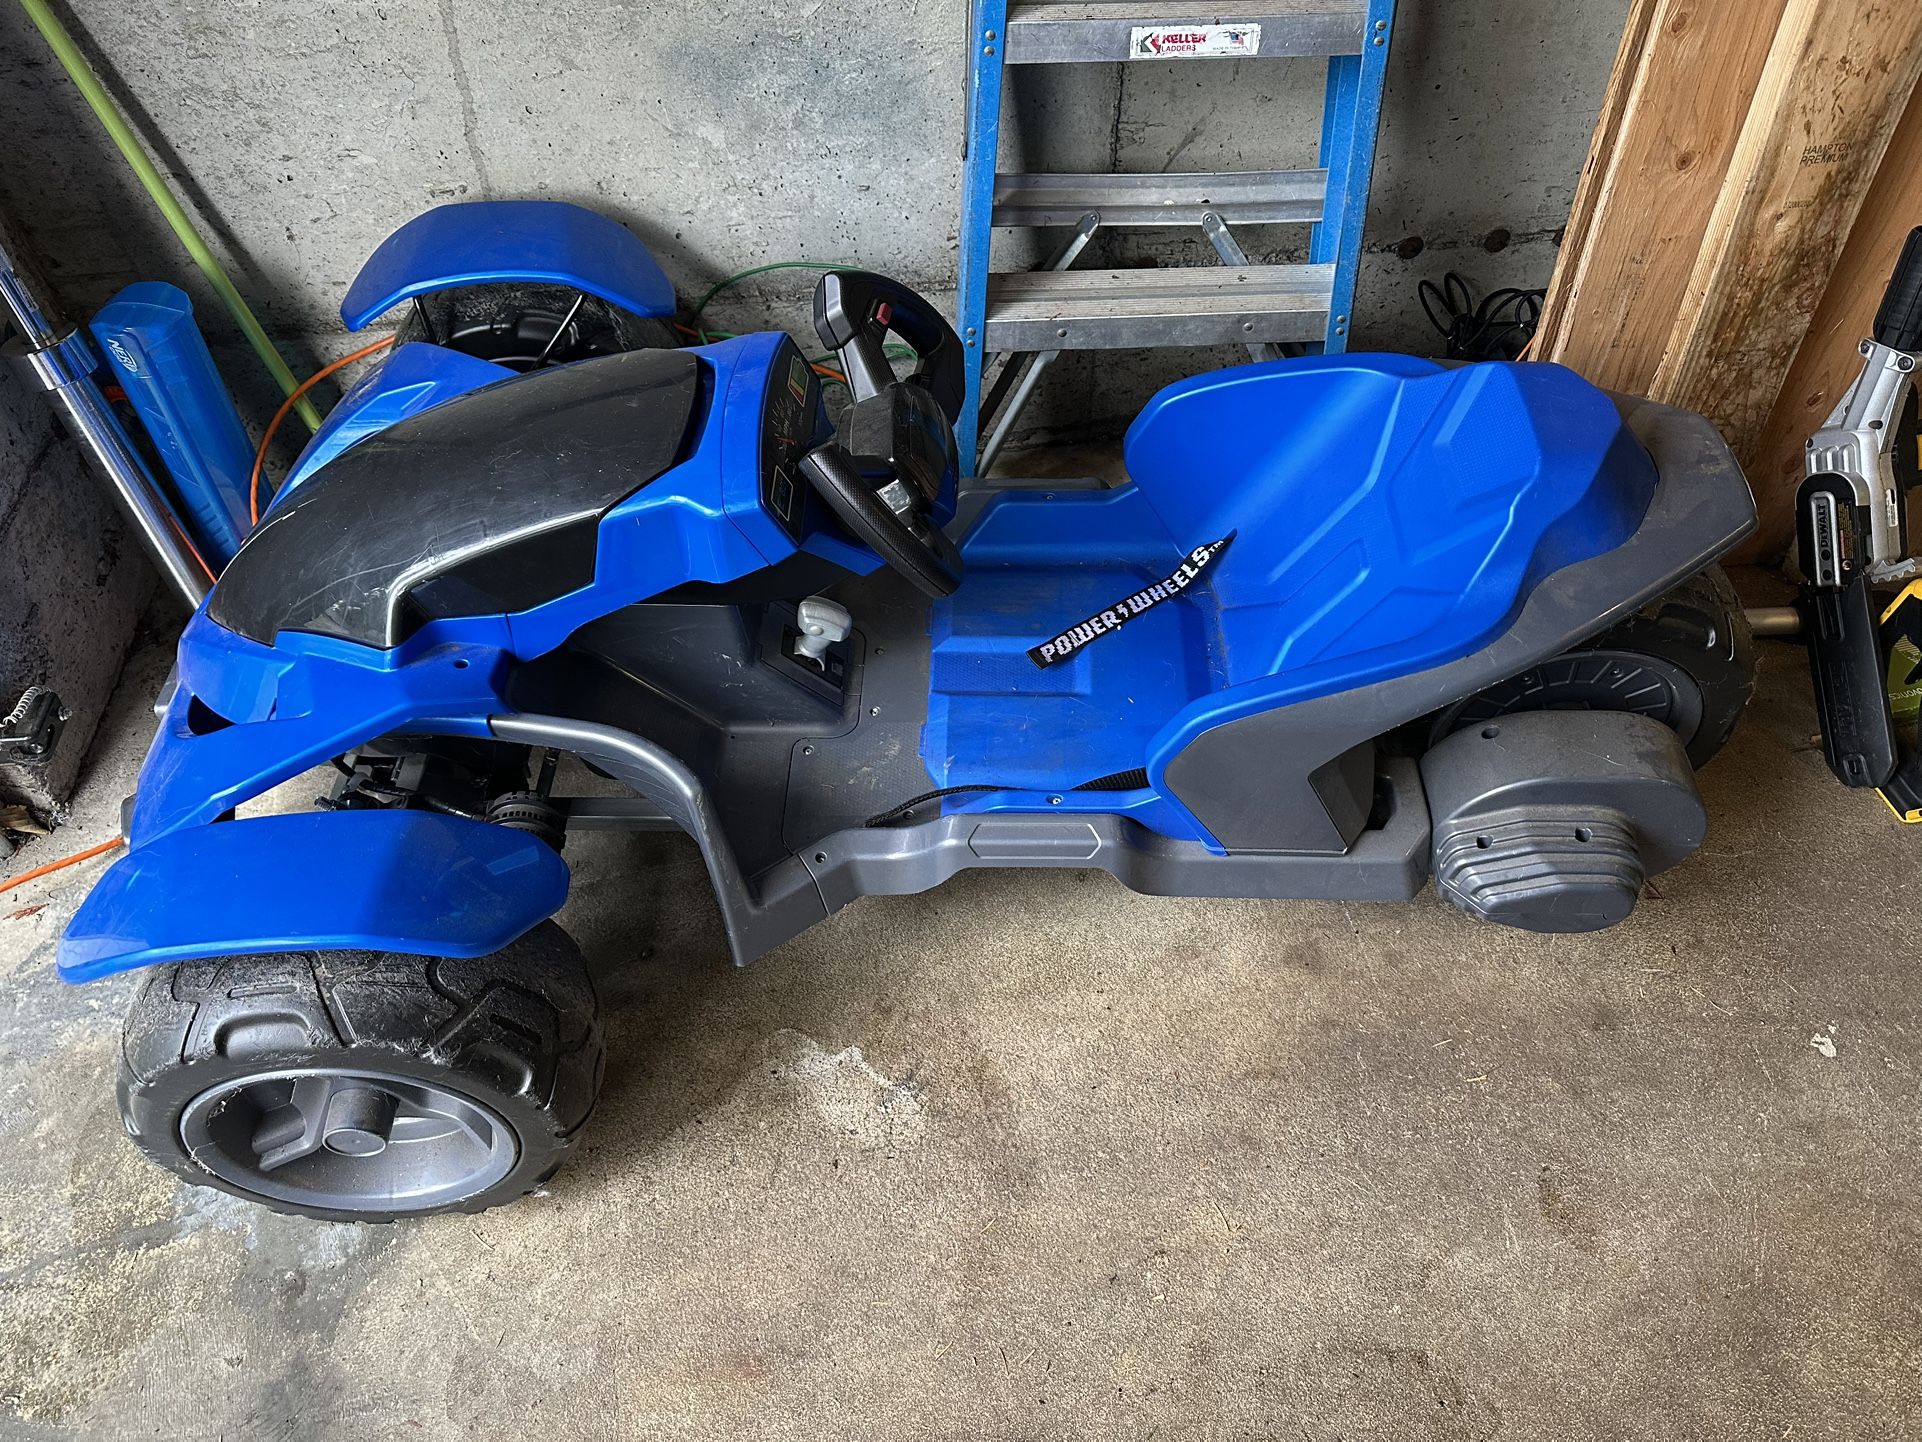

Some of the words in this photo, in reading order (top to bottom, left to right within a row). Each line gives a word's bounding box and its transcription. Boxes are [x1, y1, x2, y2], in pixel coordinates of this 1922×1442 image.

[1162, 33, 1206, 44] KELLER
[1803, 142, 1854, 155] HAMPTON
[1800, 152, 1848, 166] PREMIUM
[107, 338, 137, 371] NERF
[1039, 610, 1122, 662] POWER
